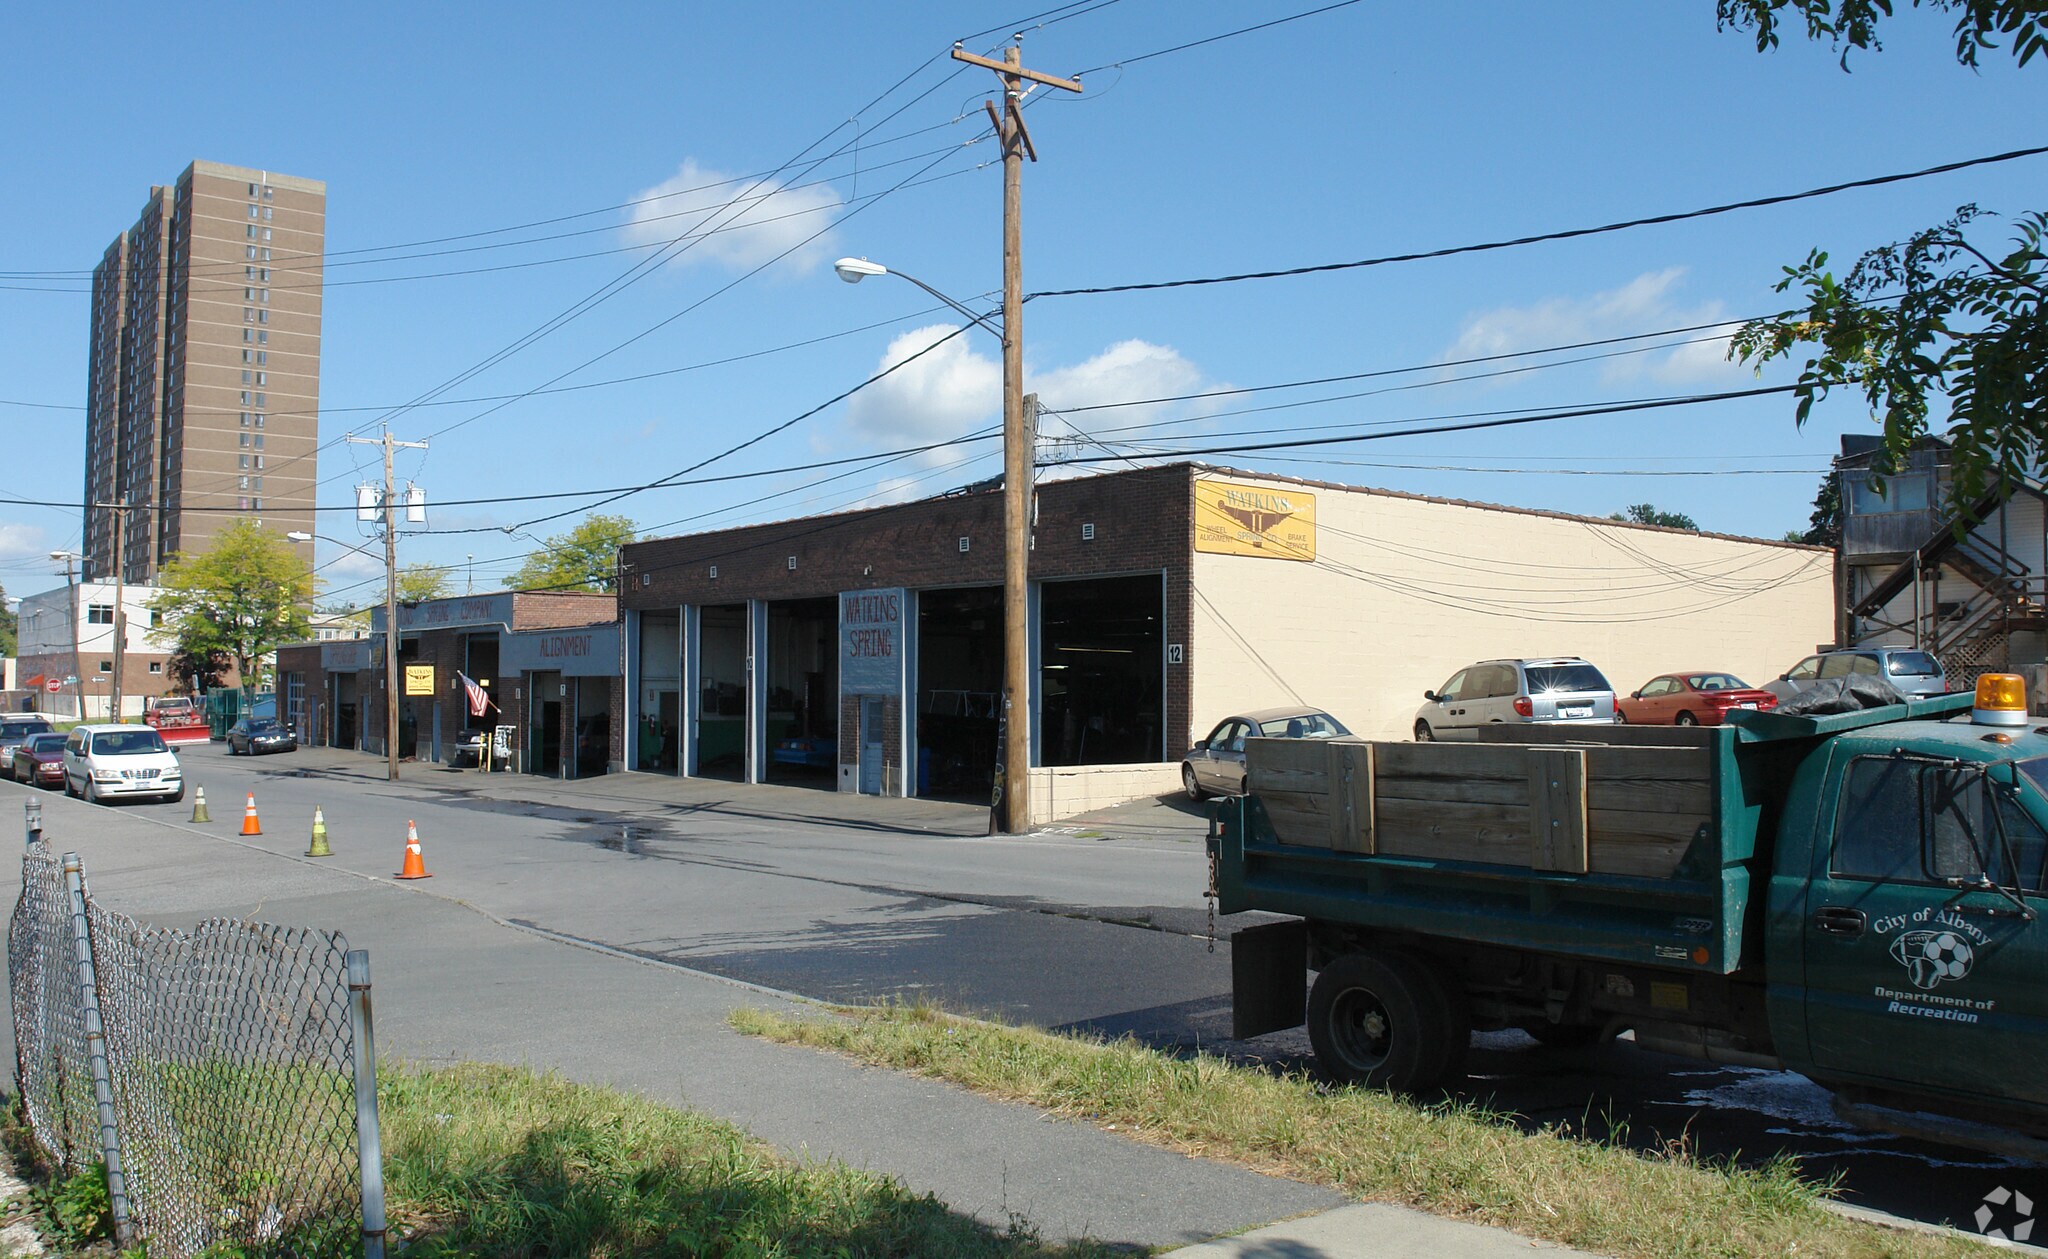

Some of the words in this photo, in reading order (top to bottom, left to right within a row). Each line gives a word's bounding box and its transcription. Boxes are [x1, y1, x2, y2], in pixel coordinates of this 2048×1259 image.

[1226, 490, 1289, 512] WATKINS
[1200, 533, 1233, 543] ALIGNMENT
[1207, 525, 1227, 534] WHEEL
[1237, 531, 1263, 542] SPRING
[1288, 533, 1307, 542] BRAKE
[1286, 542, 1308, 551] SERVICE
[460, 599, 494, 620] COMPANY
[845, 595, 898, 623] WATKINS
[540, 635, 592, 657] ALIGNMENT
[850, 629, 892, 656] SPRING
[1169, 646, 1180, 662] 12
[1873, 913, 1908, 935] City
[1912, 907, 1932, 922] of
[1934, 909, 1993, 947] Albany
[1874, 986, 1973, 1008] Department
[1976, 999, 1995, 1011] of
[1888, 1001, 1978, 1024] Recreation
